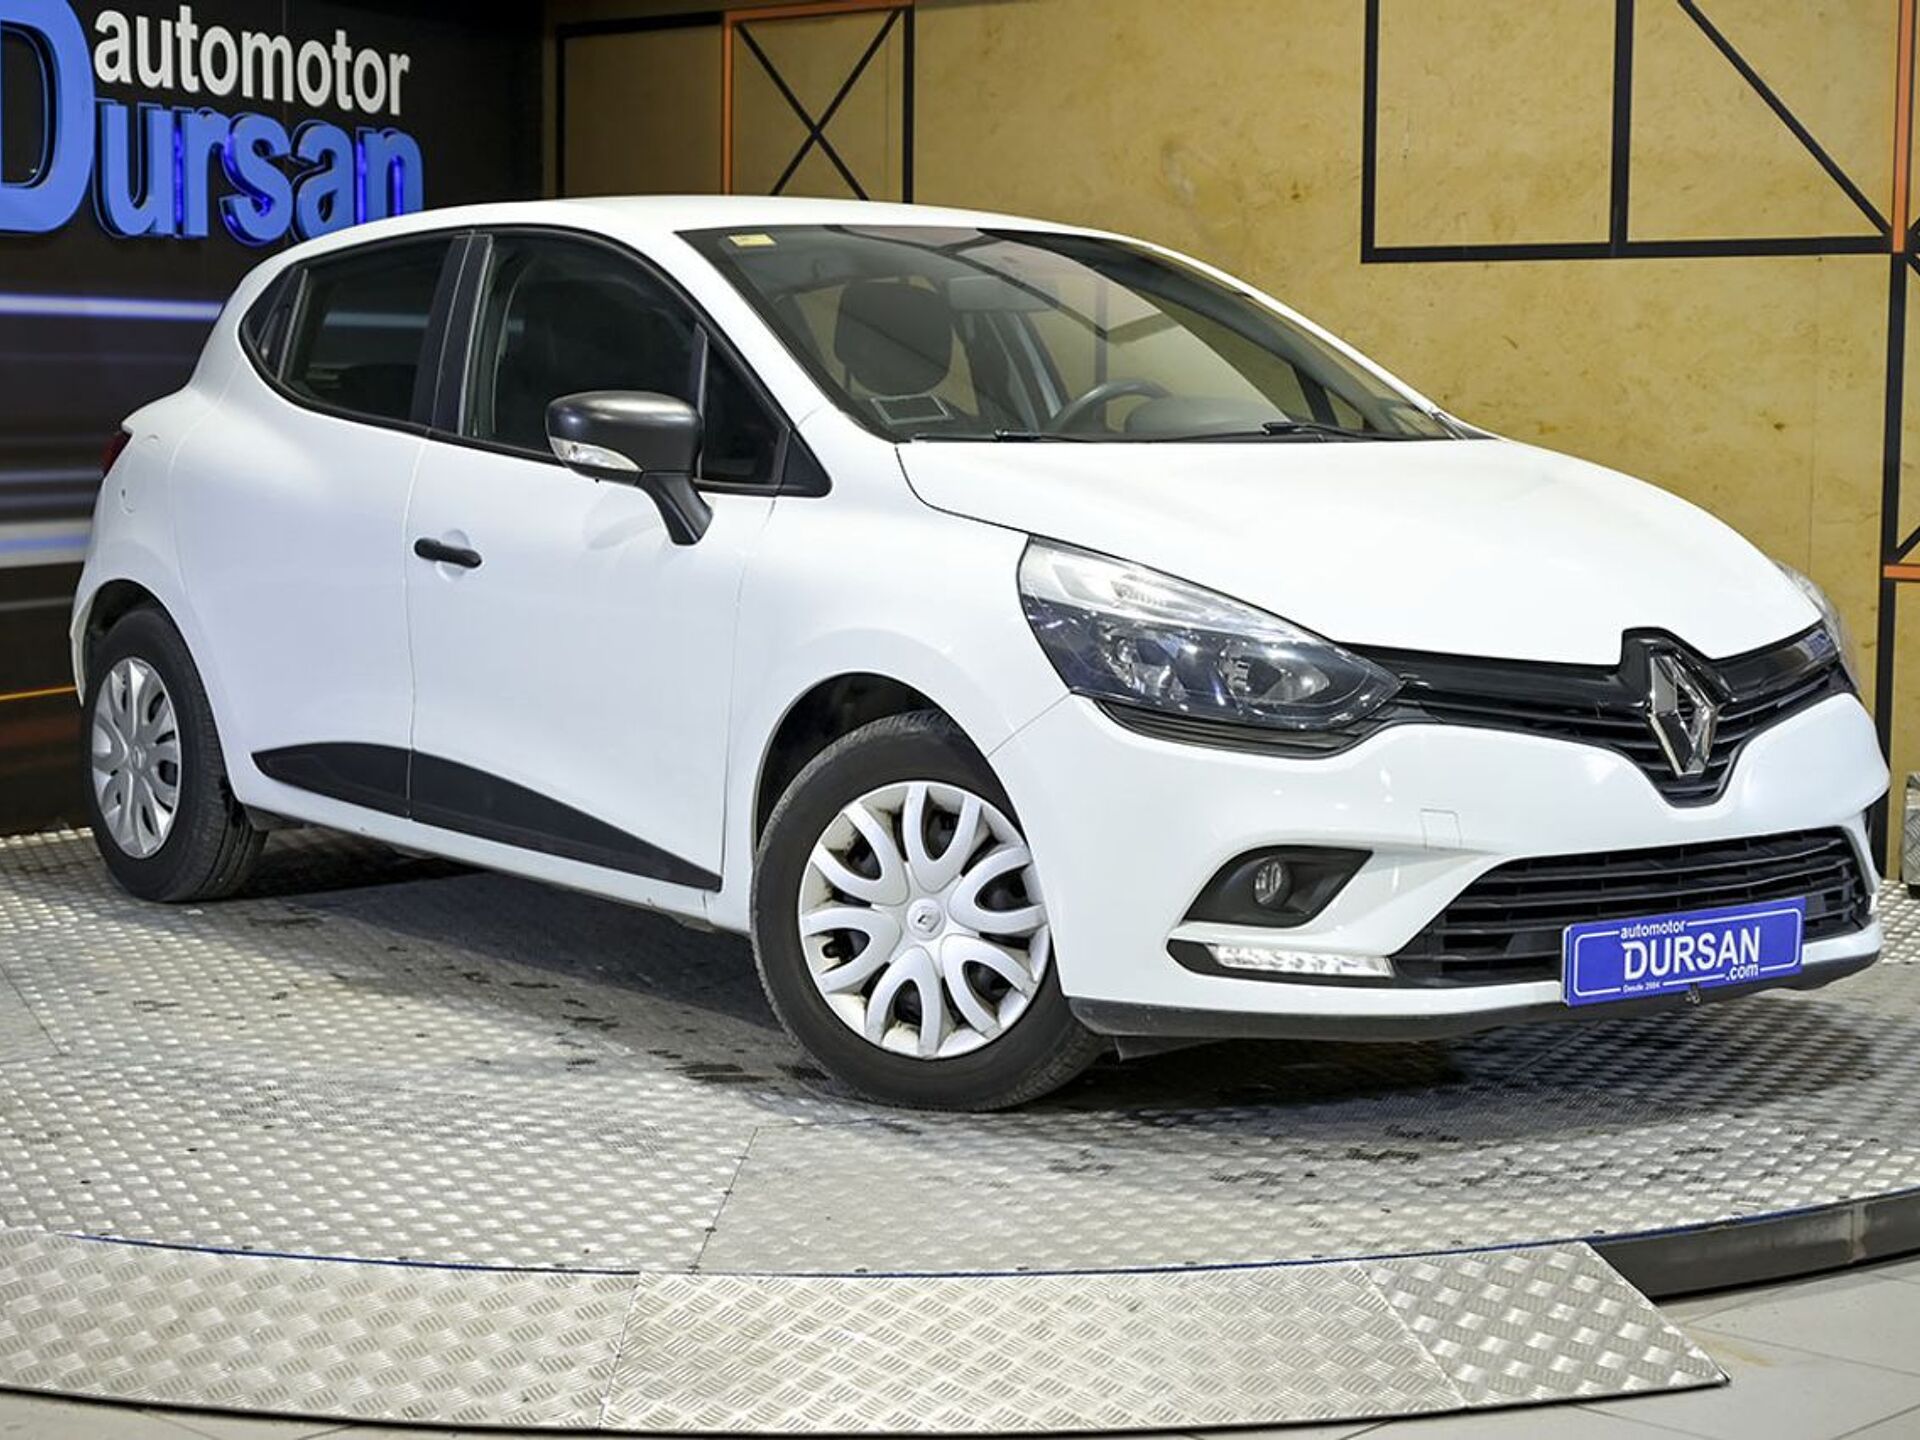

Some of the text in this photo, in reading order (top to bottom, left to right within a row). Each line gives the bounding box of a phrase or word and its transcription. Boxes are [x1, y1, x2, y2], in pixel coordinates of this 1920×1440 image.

[94, 5, 410, 116] automotor
[1620, 919, 1686, 938] automotor
[1621, 926, 1761, 980] DURSAN
